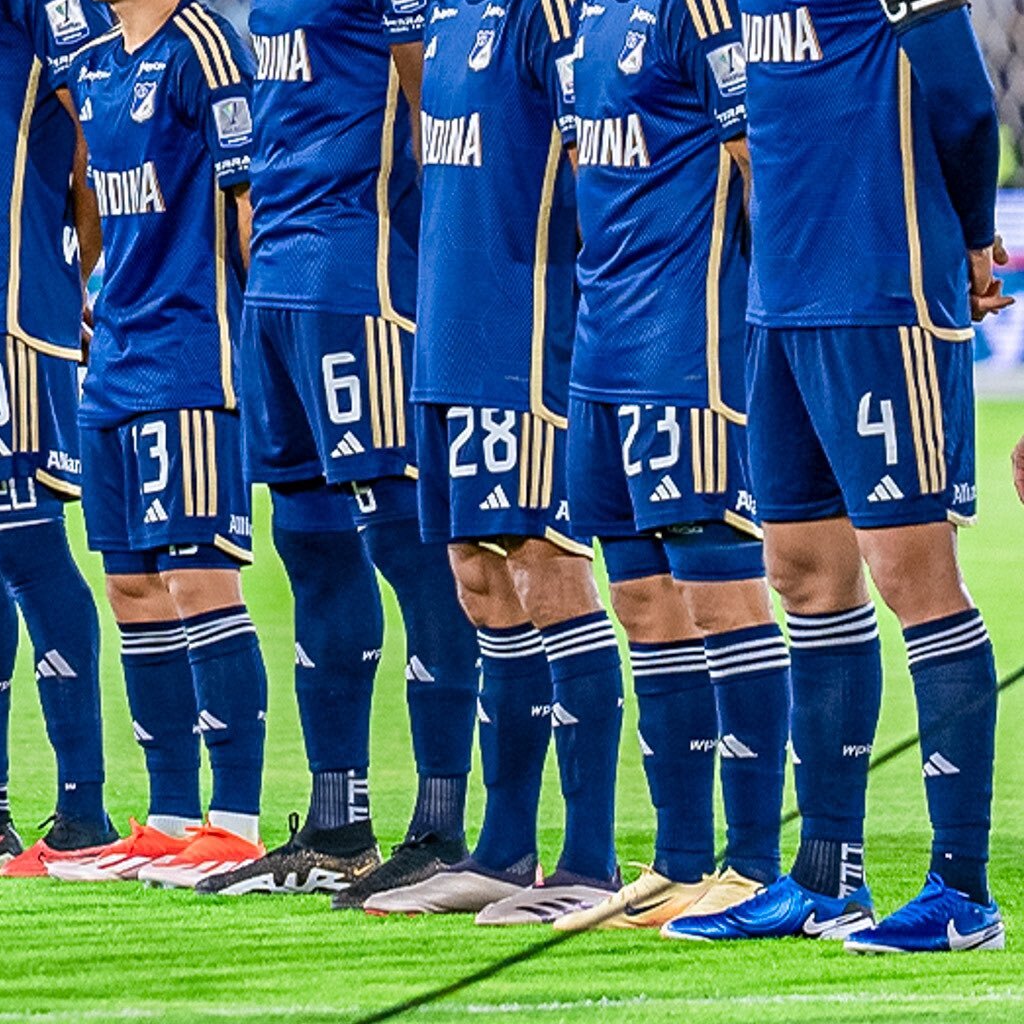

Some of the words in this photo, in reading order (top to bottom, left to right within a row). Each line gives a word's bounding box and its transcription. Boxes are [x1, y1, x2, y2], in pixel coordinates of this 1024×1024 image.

[575, 113, 651, 168] DINA
[87, 156, 166, 217] NDINA
[322, 351, 362, 424] 6
[446, 406, 518, 477] 28
[618, 405, 681, 476] 23
[857, 391, 898, 466] 4
